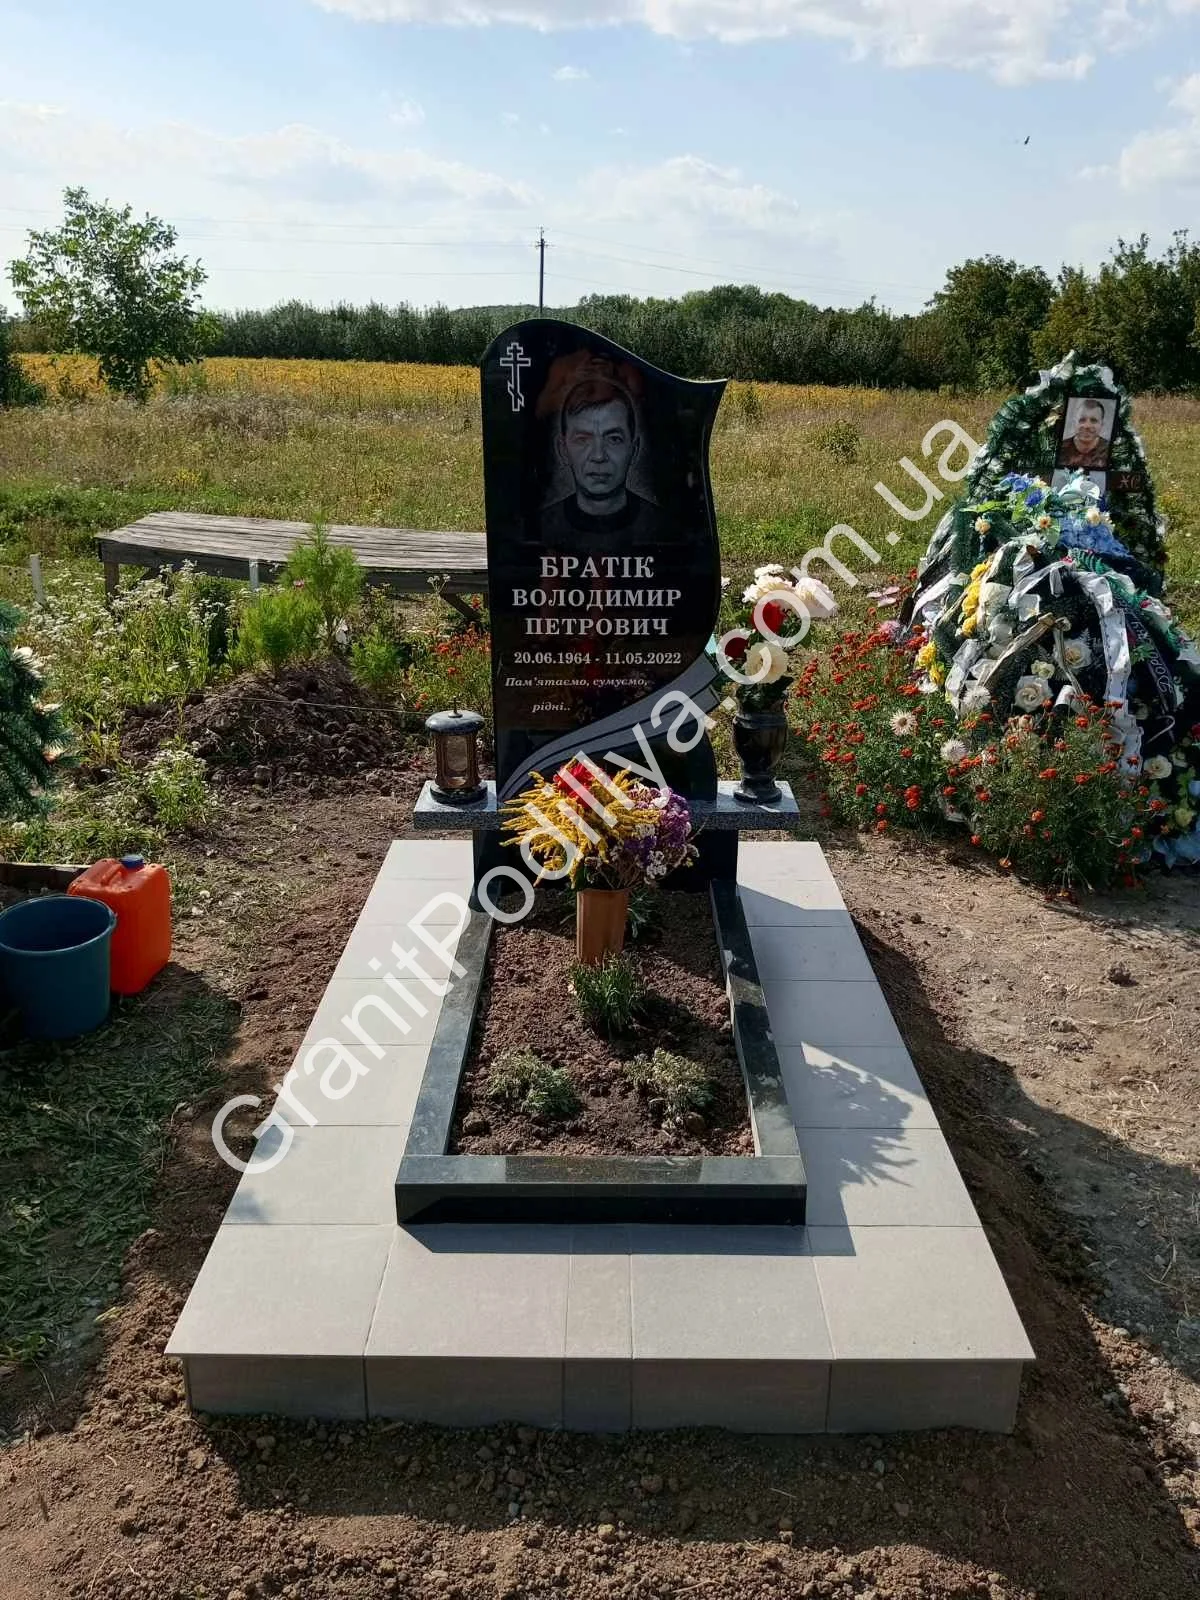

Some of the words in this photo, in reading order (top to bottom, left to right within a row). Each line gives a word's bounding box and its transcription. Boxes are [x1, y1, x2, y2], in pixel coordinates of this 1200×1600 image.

[539, 556, 655, 579] БРАТІК
[511, 588, 682, 611] ВОЛОДИМИР
[524, 617, 671, 636] ПЕТРОВИЧ
[513, 651, 592, 665] 20.06.1964
[604, 651, 682, 666] 11.05.2022
[592, 678, 649, 689] сумуємо,
